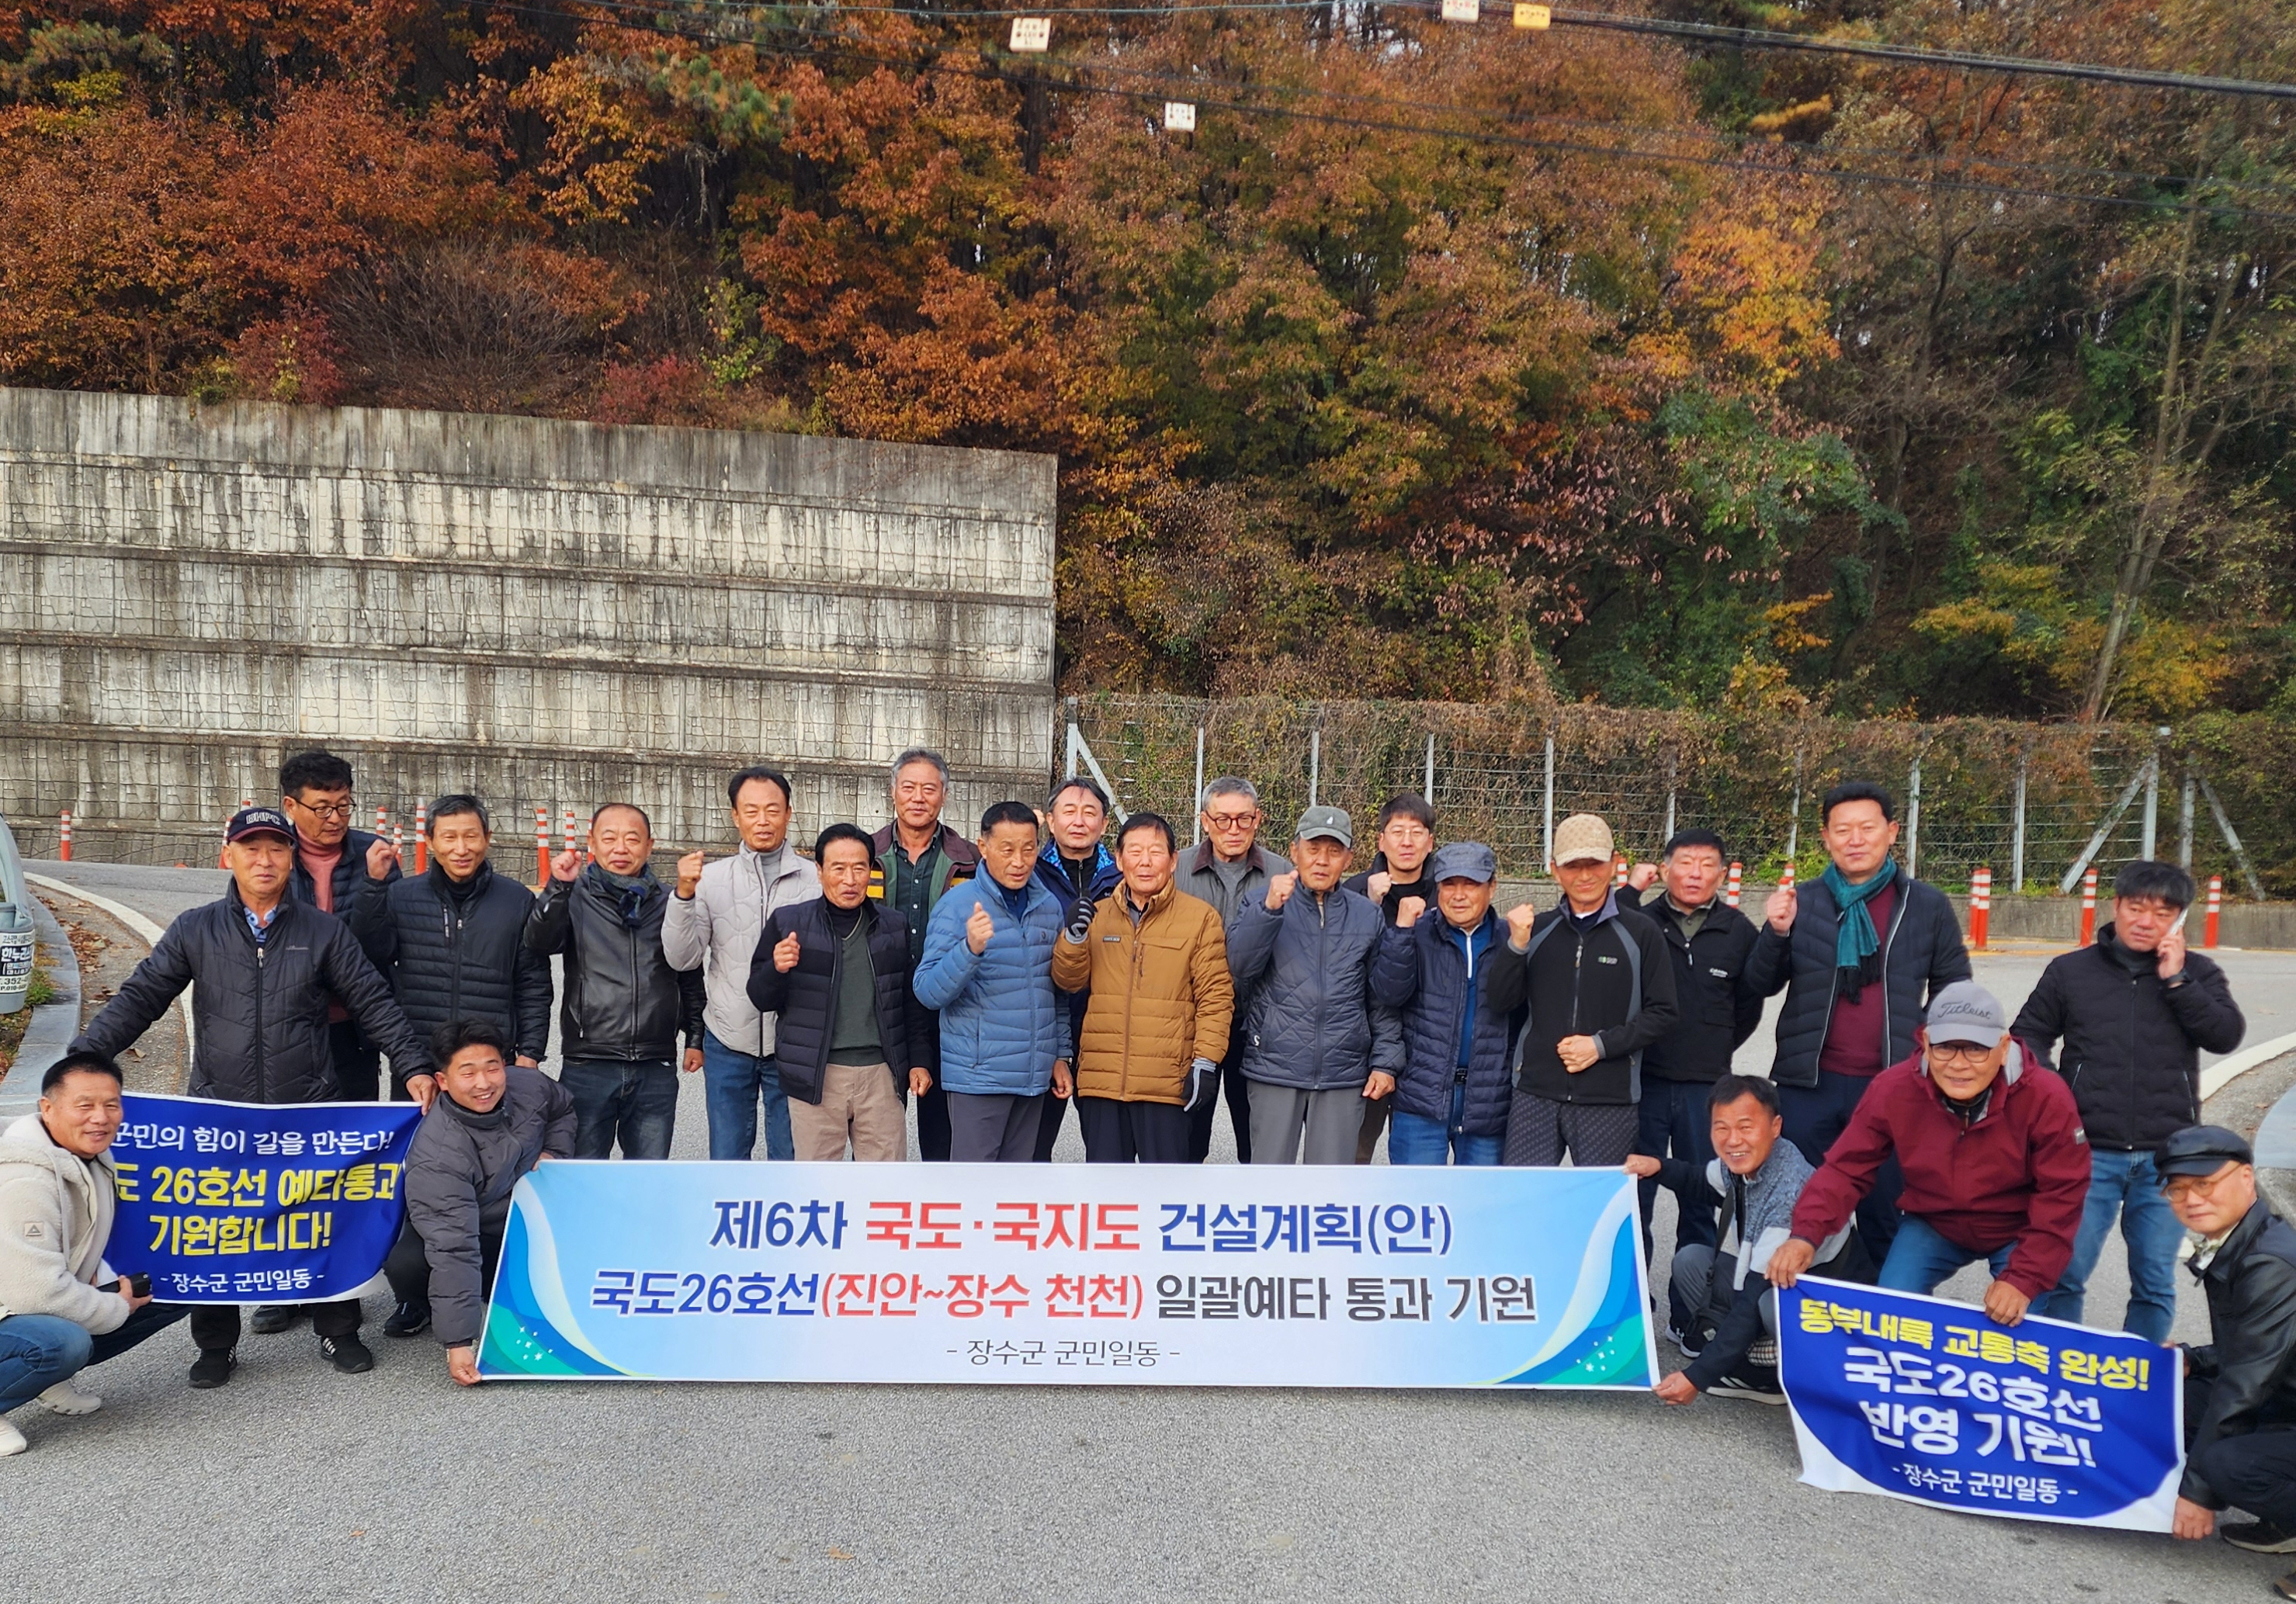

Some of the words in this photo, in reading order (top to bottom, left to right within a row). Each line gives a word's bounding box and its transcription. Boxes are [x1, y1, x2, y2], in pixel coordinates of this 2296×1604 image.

[1937, 1000, 1993, 1020] Titleist
[110, 1122, 184, 1152] 군민의
[192, 1126, 245, 1154] 힘이
[253, 1130, 306, 1155] 길을
[311, 1130, 395, 1156] 만든다!
[115, 1162, 140, 1202] 도
[151, 1166, 267, 1207] 26호선
[277, 1162, 401, 1207] 예타통과
[149, 1211, 332, 1256] 기원합니다!
[709, 1200, 848, 1250] 제6차
[1159, 1203, 1451, 1256] 건설계획(안)
[1044, 1273, 1143, 1320] 천천)
[1156, 1273, 1331, 1321] 일괄예타
[1346, 1276, 1434, 1322] 통과
[1446, 1274, 1538, 1322] 기원
[1799, 1298, 1934, 1350] 동부내륙
[1943, 1324, 2051, 1374] 교통축
[2058, 1349, 2151, 1391] 완성!
[1843, 1346, 2104, 1433] 국도26호선
[1858, 1400, 1959, 1456] 반영
[1972, 1412, 2097, 1468] 기원!
